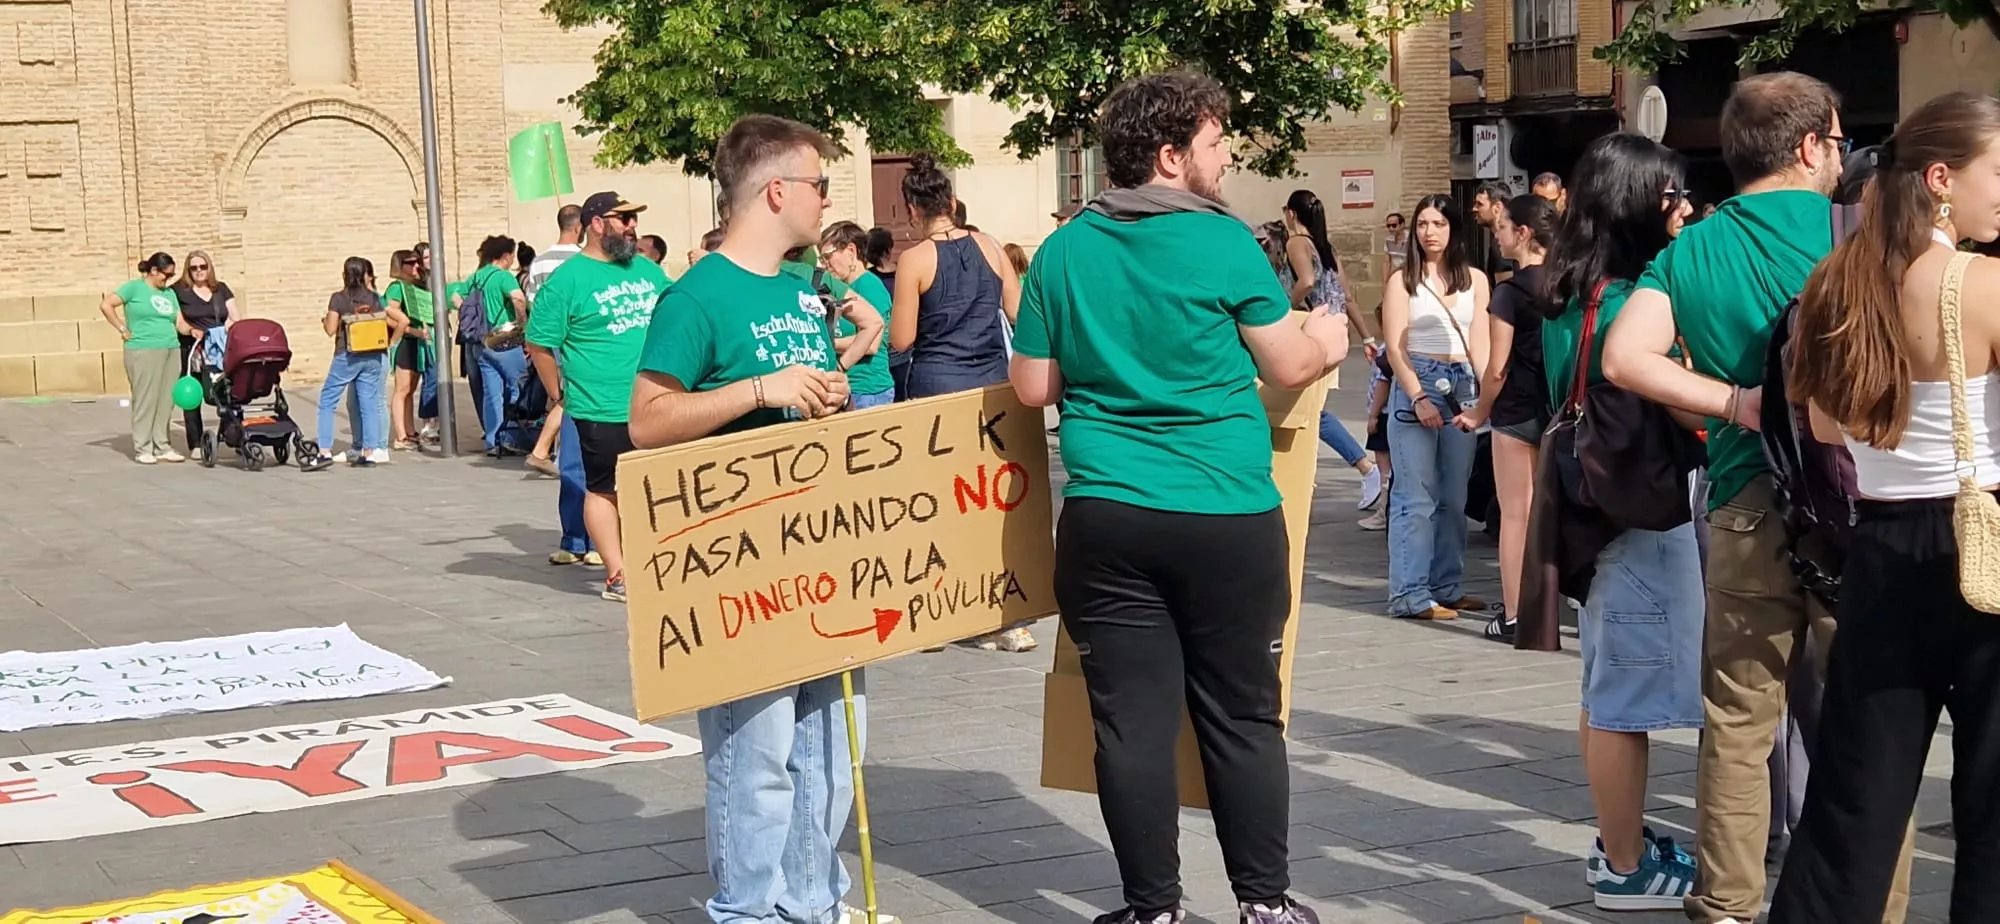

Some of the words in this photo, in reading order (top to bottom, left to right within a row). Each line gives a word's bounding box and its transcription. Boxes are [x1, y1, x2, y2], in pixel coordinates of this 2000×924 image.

[643, 441, 829, 532] HESTO
[846, 426, 902, 474] ES
[928, 415, 953, 457] L
[978, 410, 1006, 452] K
[644, 529, 760, 591] PASA
[781, 492, 938, 555] KUANDO
[953, 462, 1029, 514] NO
[659, 607, 702, 670] AI
[718, 572, 838, 639] DINERO
[850, 557, 892, 599] PA
[904, 541, 946, 585] LA
[908, 571, 1028, 632] PÚVLIKA
[9, 746, 188, 772] I.E.S.
[206, 698, 572, 749] PIRÁMIDE
[86, 714, 674, 818] ¡YA!
